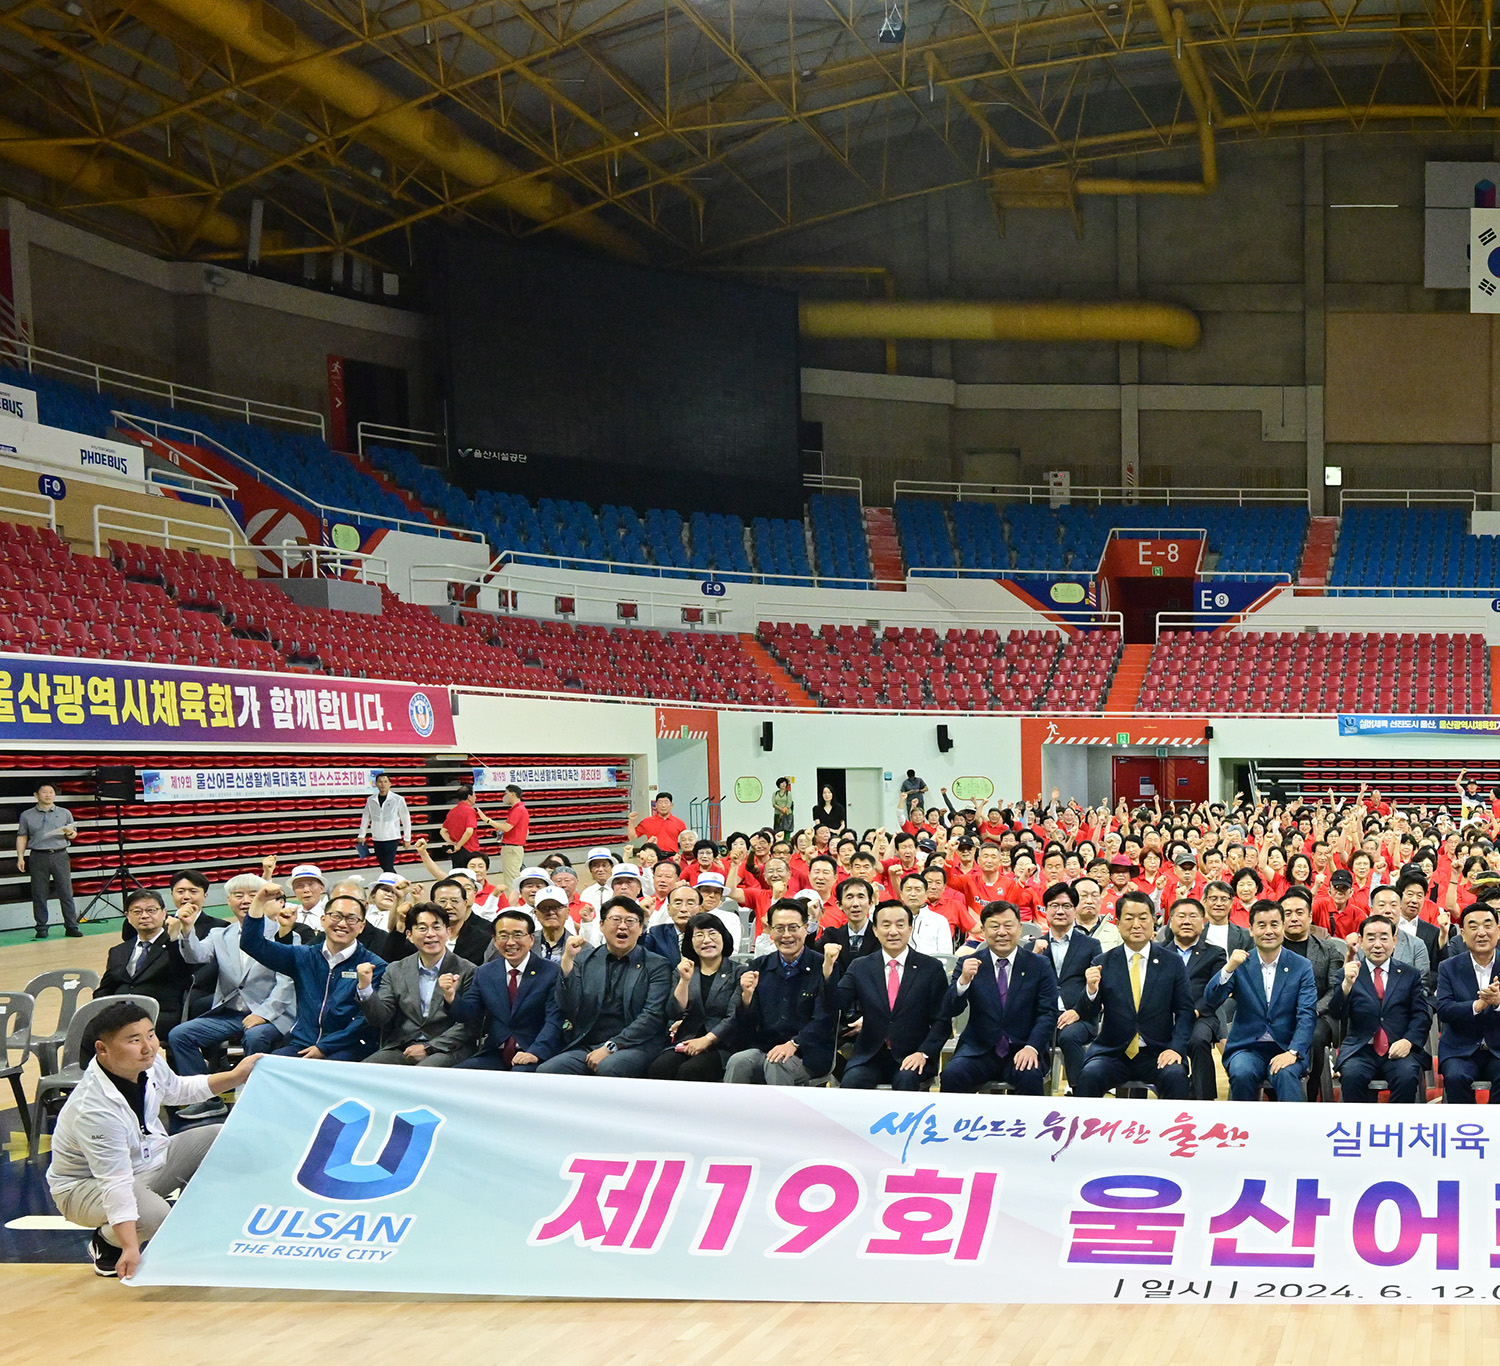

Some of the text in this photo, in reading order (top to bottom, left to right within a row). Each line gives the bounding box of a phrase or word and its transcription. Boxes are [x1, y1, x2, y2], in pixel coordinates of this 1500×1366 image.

[80, 449, 128, 475] PHOEBUS
[474, 449, 527, 463] 울산시설공단
[1138, 541, 1179, 565] E-8
[270, 686, 392, 731] 함께합니다.
[1390, 720, 1419, 728] 선진도시
[170, 771, 366, 790] 제19회 울산어르신생활체육대축전 댄스스포츠대회
[869, 1103, 1250, 1163] 새로 만드는 위대한 울산
[1326, 1121, 1490, 1160] 실버체육
[536, 1158, 998, 1261] 제19회
[247, 1207, 412, 1243] ULSAN
[232, 1242, 392, 1261] THE RISING CITY
[1141, 1279, 1212, 1299] 일시
[1253, 1283, 1363, 1298] 2024.
[1379, 1284, 1413, 1299] 6.
